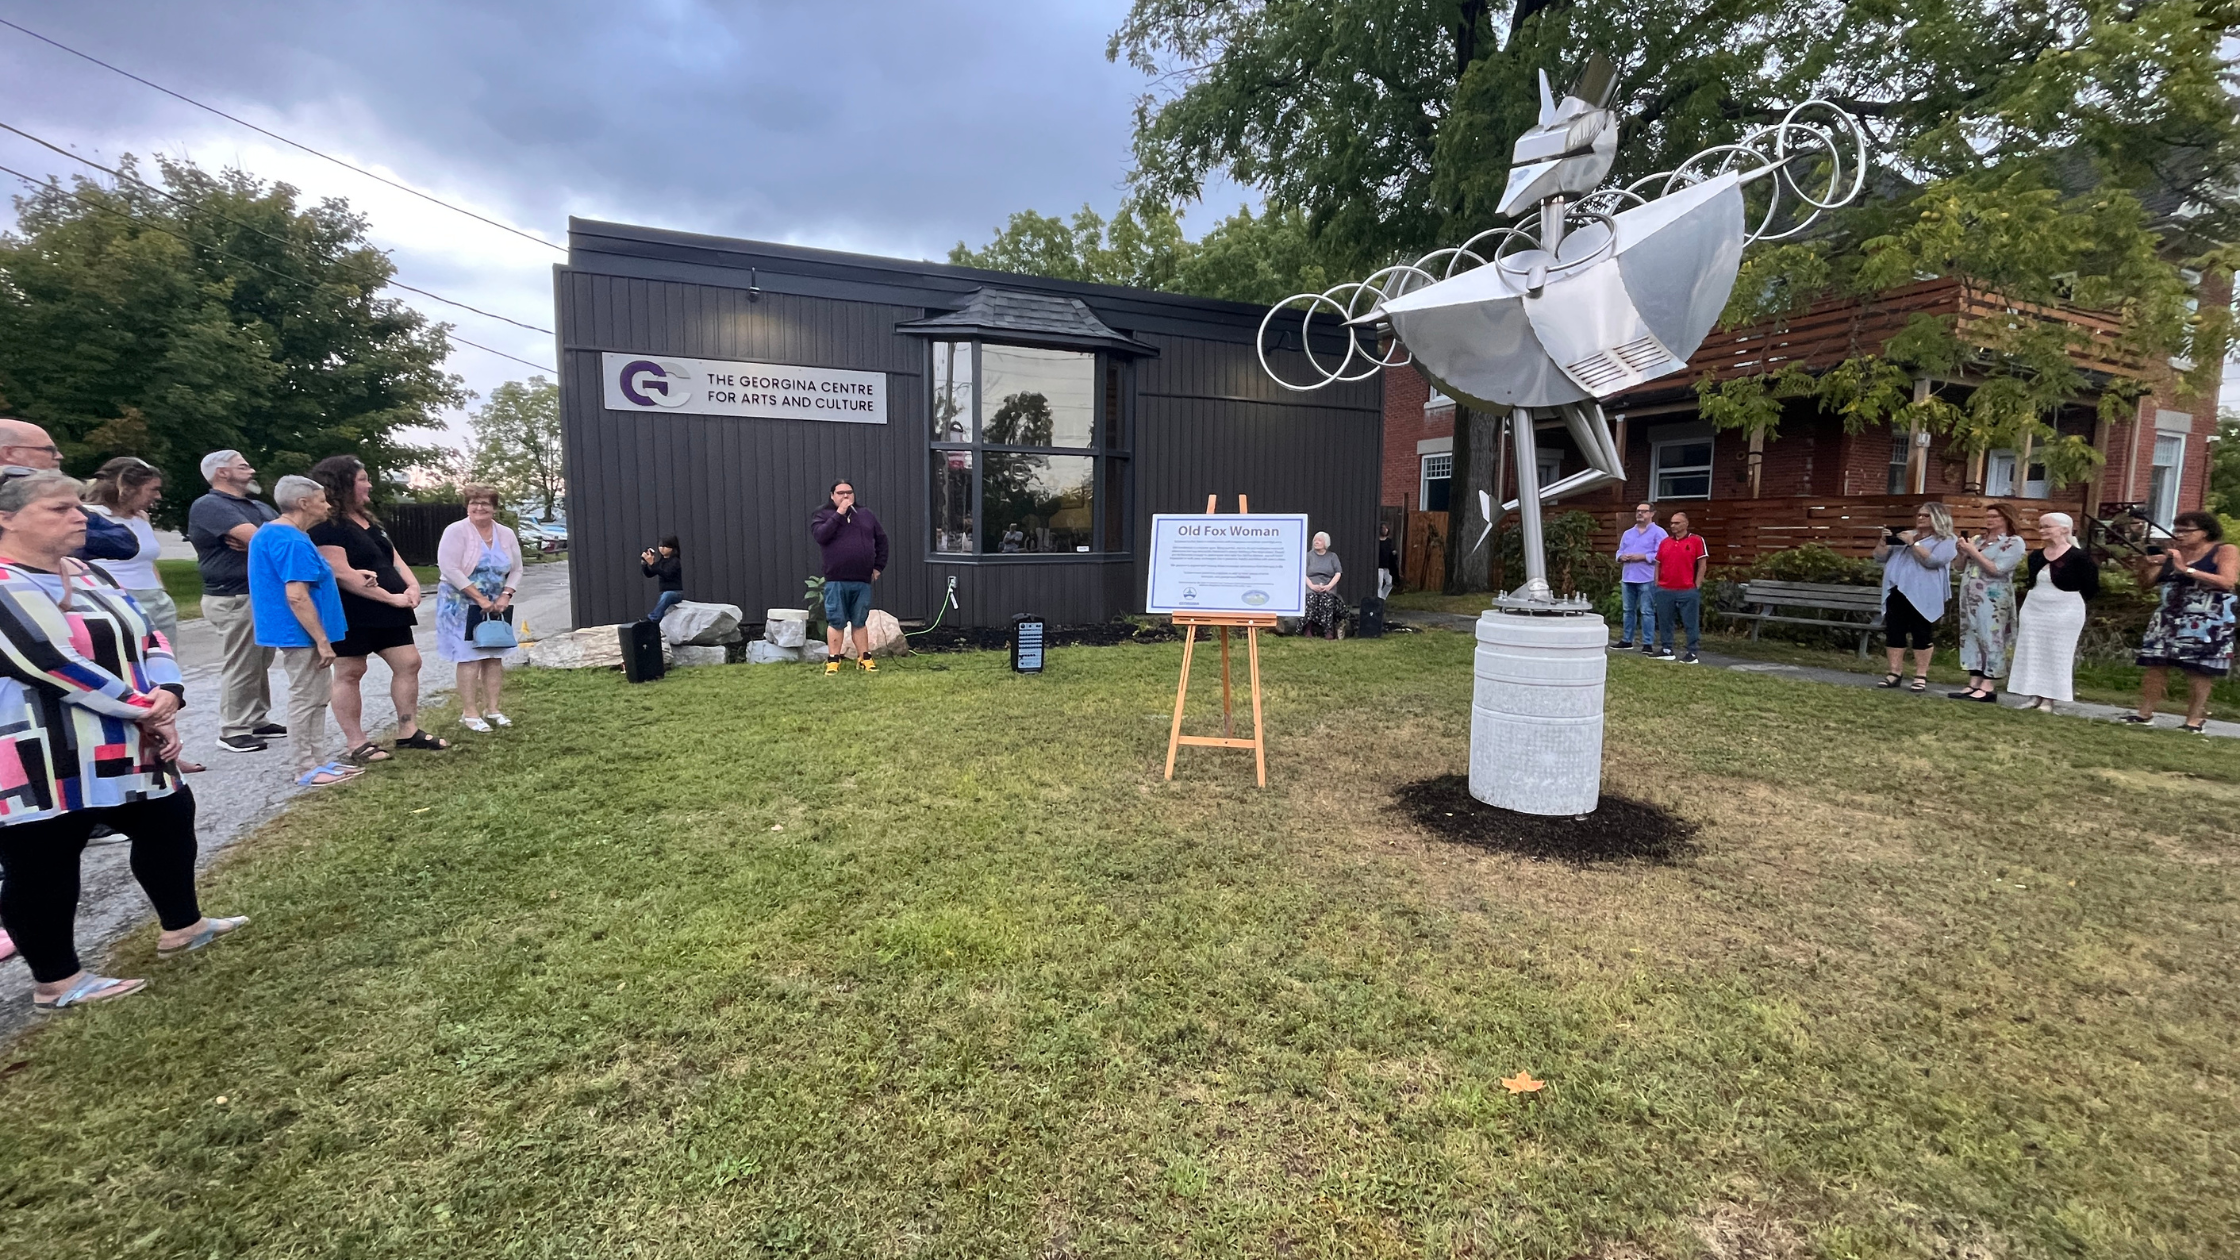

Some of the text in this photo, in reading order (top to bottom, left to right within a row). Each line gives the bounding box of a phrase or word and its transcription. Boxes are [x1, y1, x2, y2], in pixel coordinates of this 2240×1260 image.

[707, 373, 873, 396] THE GEORGINA CENTRE
[708, 391, 874, 412] FOR ARTS AND CULTURE
[1178, 525, 1279, 537] Old Fox Woman
